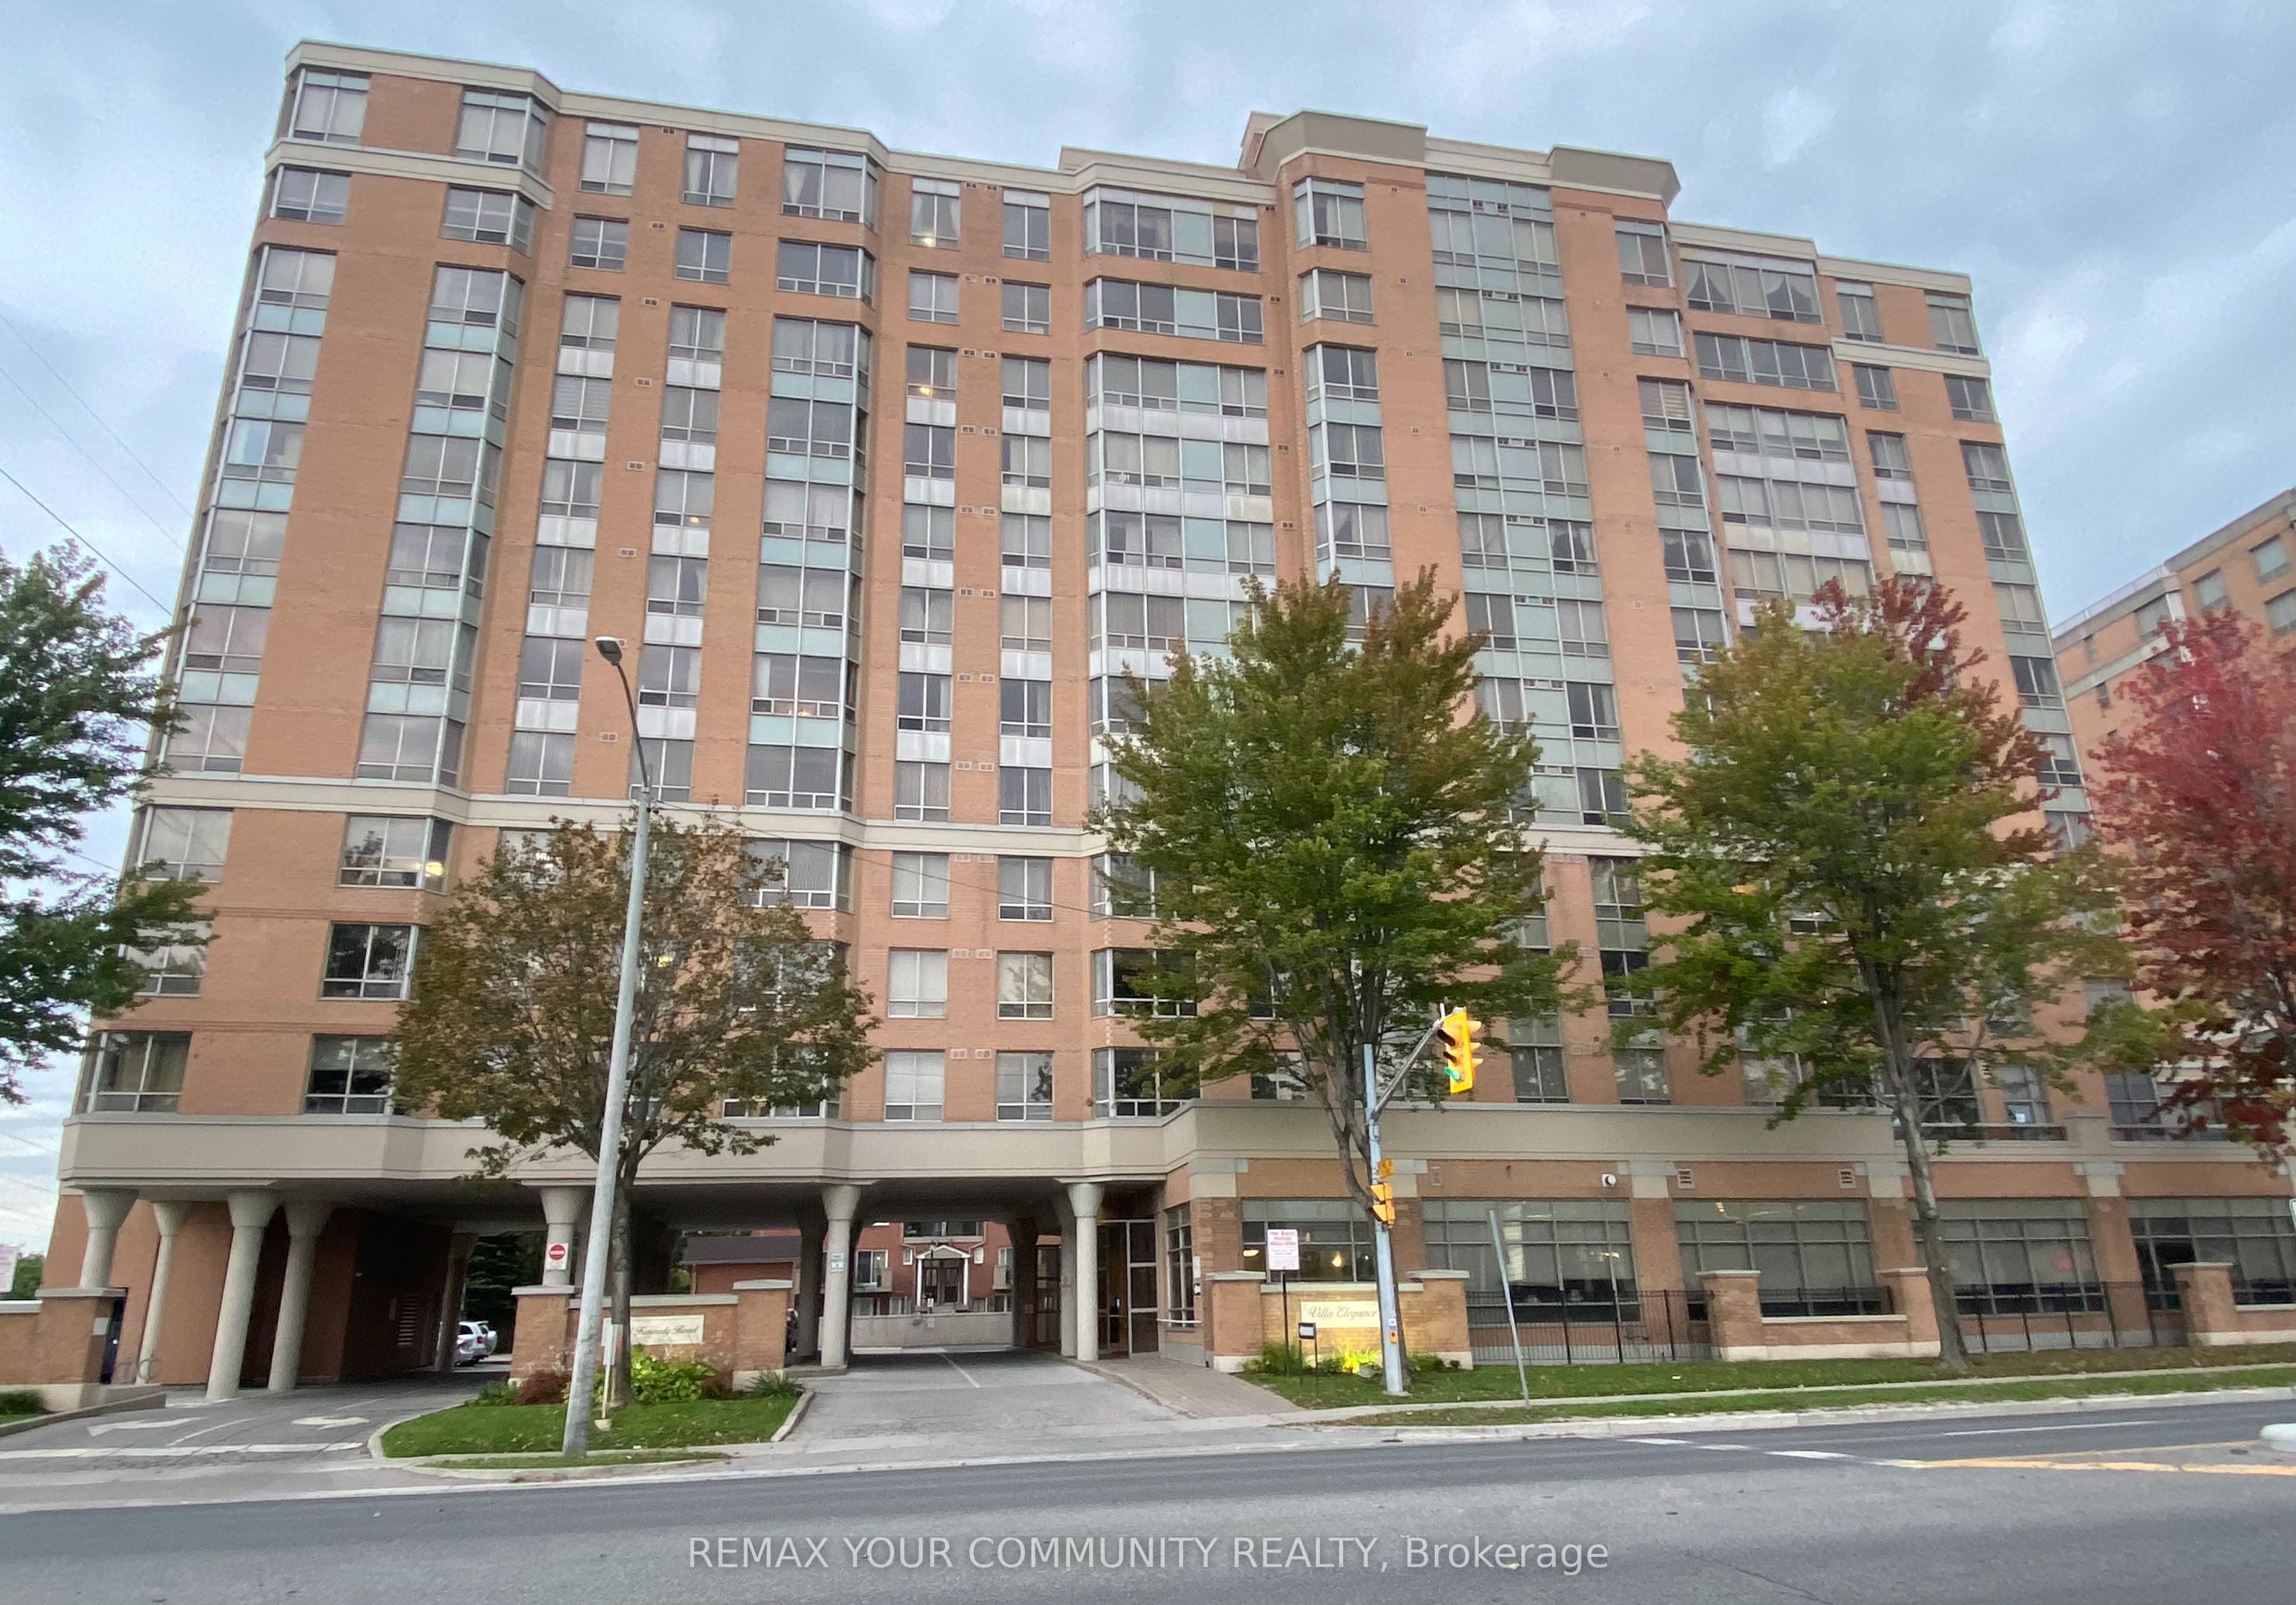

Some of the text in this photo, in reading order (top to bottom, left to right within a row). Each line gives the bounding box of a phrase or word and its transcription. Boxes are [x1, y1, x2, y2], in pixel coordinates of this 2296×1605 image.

[1308, 1306, 1377, 1321] Villa Elegance
[633, 1324, 700, 1336] Kennedy Road
